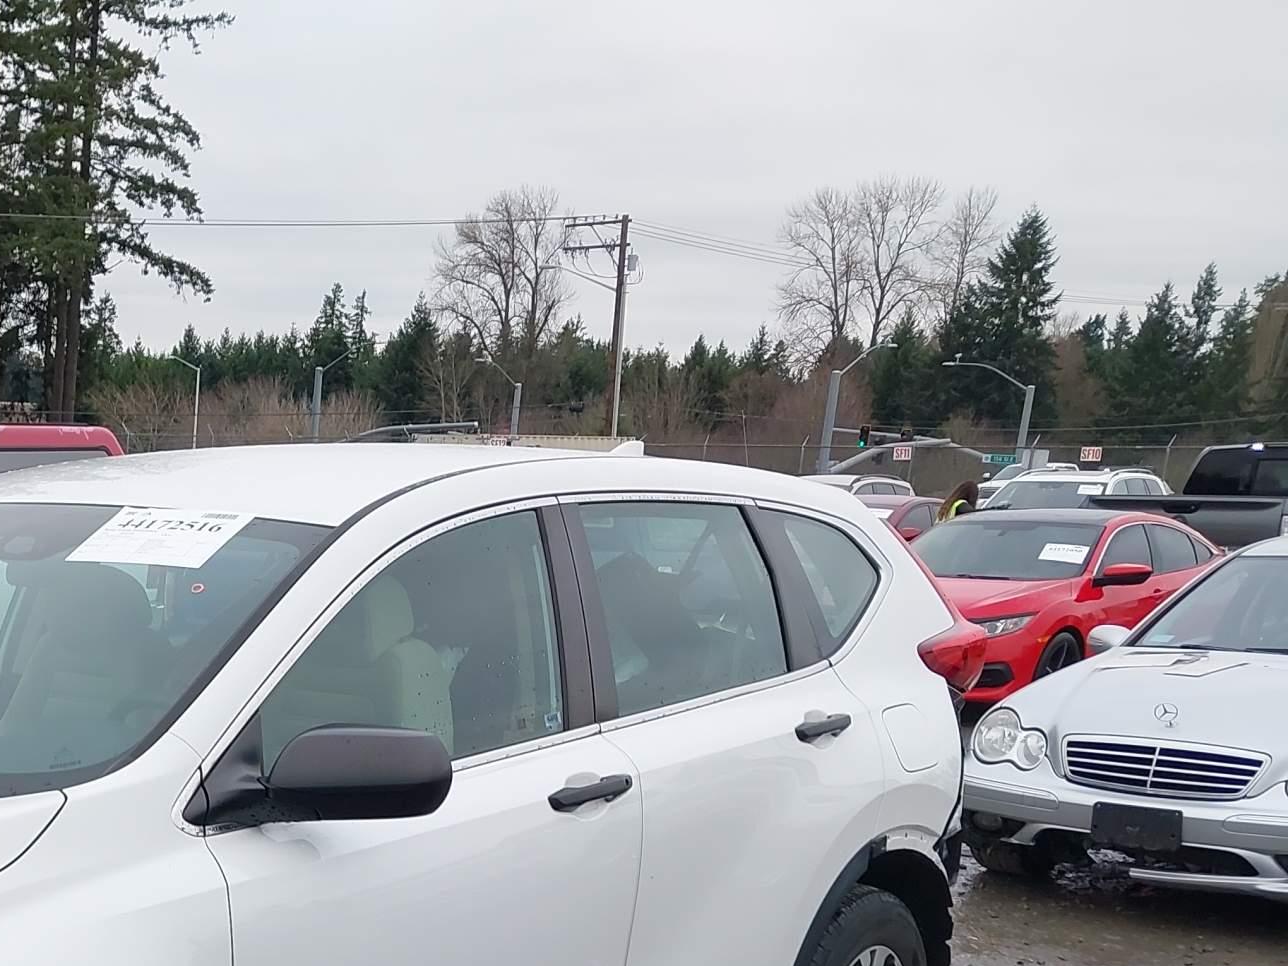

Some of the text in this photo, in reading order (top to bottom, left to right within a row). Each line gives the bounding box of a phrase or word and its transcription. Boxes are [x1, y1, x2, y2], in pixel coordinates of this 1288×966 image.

[895, 448, 911, 459] SF11
[1081, 448, 1101, 460] SF10
[117, 517, 225, 534] 44172516
